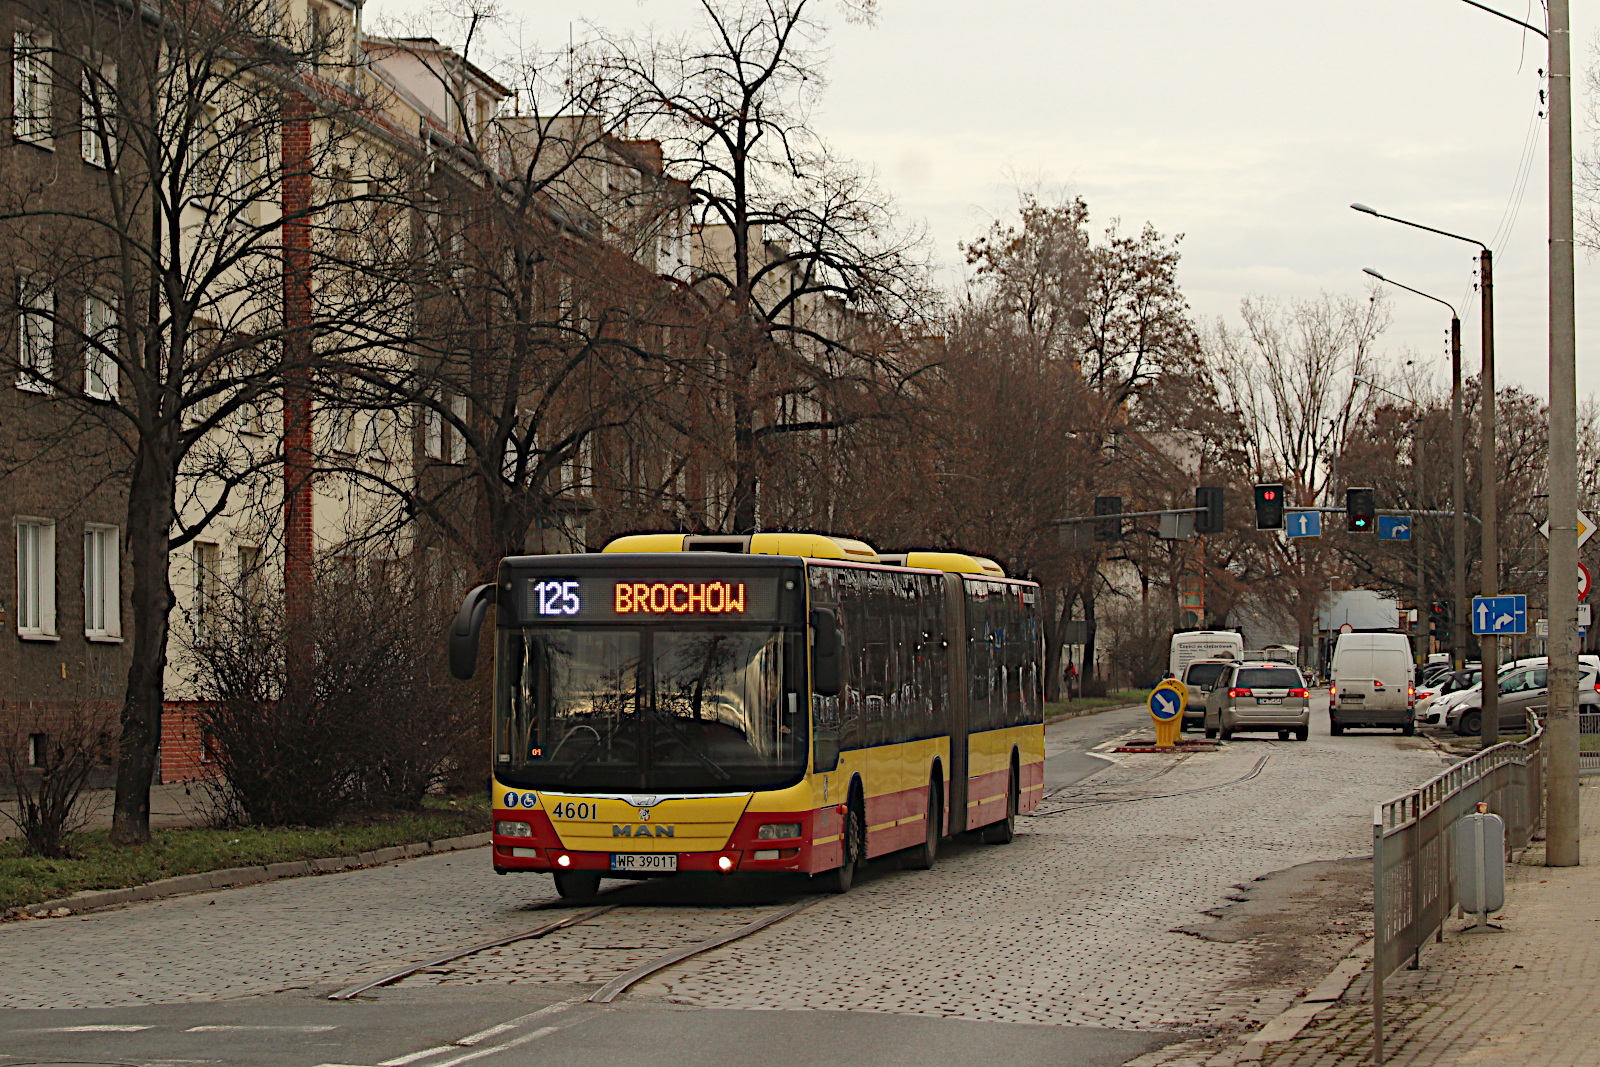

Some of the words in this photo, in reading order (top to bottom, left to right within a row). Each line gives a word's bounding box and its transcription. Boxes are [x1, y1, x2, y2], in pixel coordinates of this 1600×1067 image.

[534, 581, 580, 615] 125
[614, 581, 745, 613] BROCHÓW
[531, 748, 542, 756] 01
[552, 802, 598, 820] 4601
[612, 824, 675, 838] MAN
[618, 856, 635, 867] WR
[639, 856, 675, 867] 3901T
